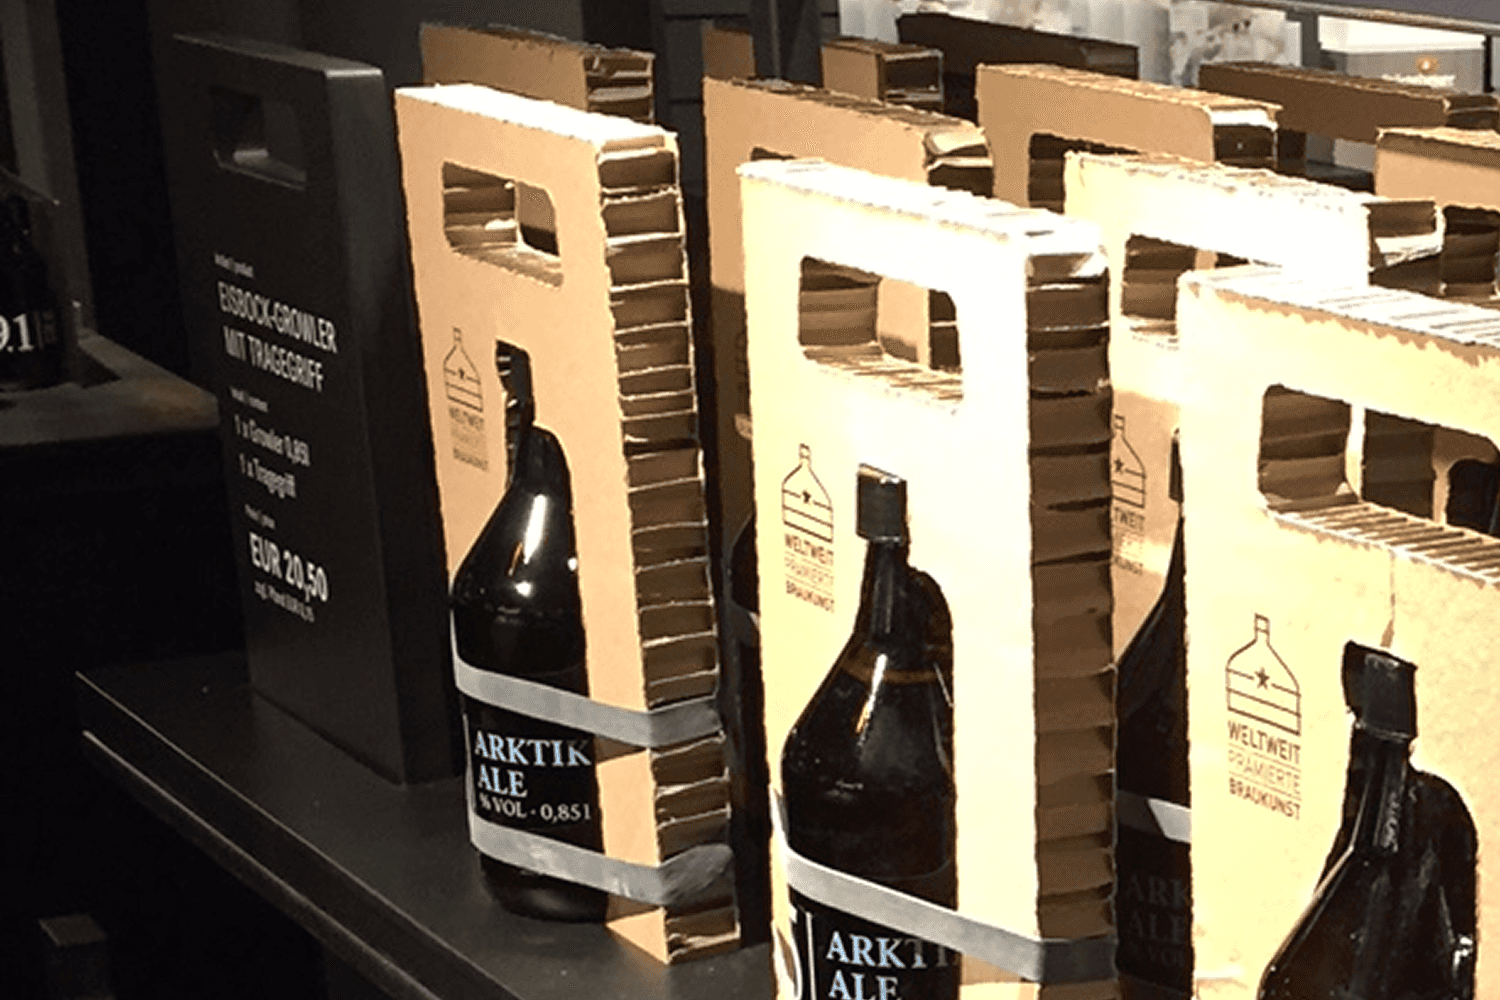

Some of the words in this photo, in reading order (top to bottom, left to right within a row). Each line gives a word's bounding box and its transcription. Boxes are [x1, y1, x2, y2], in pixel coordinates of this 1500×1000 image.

[217, 280, 338, 354] EISBOCK-GROWLER
[223, 325, 247, 362] MIT
[247, 334, 324, 393] TRAGEGRIFF
[249, 531, 282, 579] EUR
[282, 549, 329, 603] 20,50
[474, 729, 592, 767] ARKTIK
[1226, 719, 1301, 766] WELTWEIT
[477, 763, 529, 798] ALE
[1229, 777, 1301, 821] BRAUKUNST
[491, 796, 527, 819] VOL
[826, 930, 960, 970] ARKTI
